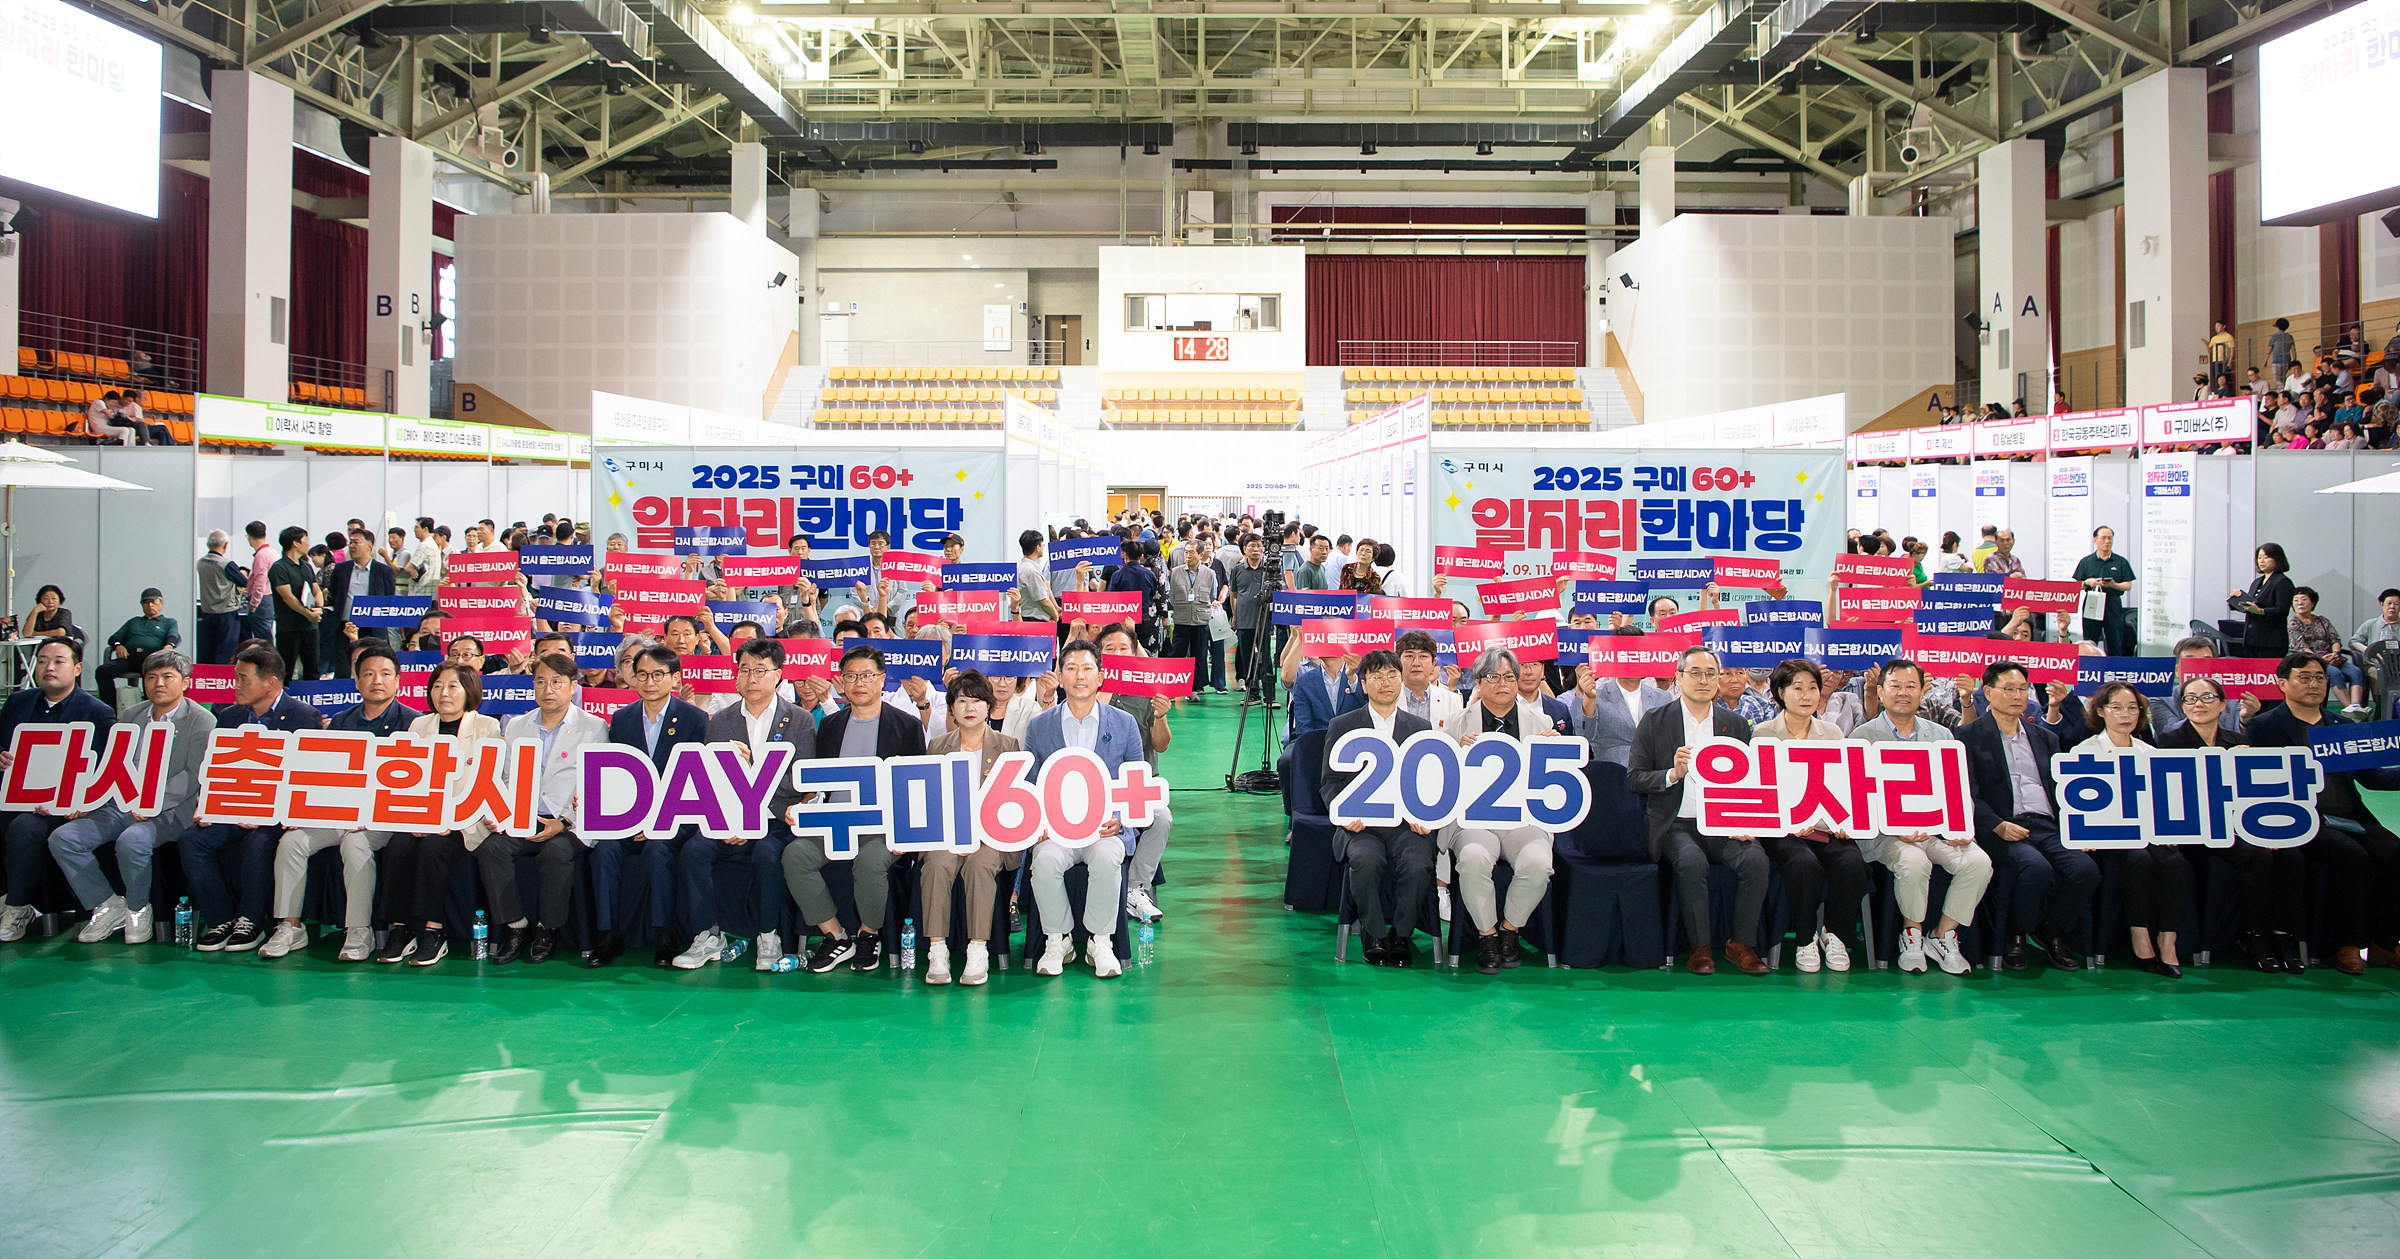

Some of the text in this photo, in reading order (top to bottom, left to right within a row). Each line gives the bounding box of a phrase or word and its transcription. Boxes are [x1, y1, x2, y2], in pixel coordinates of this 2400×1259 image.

[2323, 27, 2355, 51] 2025
[376, 295, 392, 317] B
[411, 293, 420, 315] B
[1993, 291, 2002, 314] A
[2021, 294, 2039, 317] A
[1176, 337, 1228, 360] 14 28
[462, 392, 477, 412] B
[1927, 393, 1943, 412] A
[275, 417, 299, 433] 이력서
[301, 420, 316, 435] 사진
[318, 422, 332, 436] 촬영
[2174, 416, 2228, 435] 구미버스(주)
[2000, 432, 2026, 446] 강남병원
[2061, 423, 2131, 442] 한국공동주택관리(주)
[625, 460, 664, 472] 구미시
[1463, 462, 1504, 473] 구미시
[692, 464, 914, 490] 2025 구미 60+
[1533, 465, 1756, 492] 2025 구미 60+
[675, 536, 745, 546] 다시 출근합시DAY
[521, 555, 592, 565] 다시 출근합시DAY
[1050, 546, 1119, 561] 다시 출근합시DAY
[449, 561, 517, 573] 다시 출근합시DAY
[606, 563, 625, 572] 다시
[625, 564, 679, 575] 출근합시DAY
[881, 561, 896, 571] 다시
[1436, 557, 1503, 570] 다시 출근합시DAY
[1512, 564, 1532, 576] 09.
[1553, 562, 1568, 572] 다시
[1568, 562, 1616, 575] 출근합시DAY
[725, 567, 742, 577] 다시
[743, 565, 798, 577] 출근합시DAY
[801, 567, 870, 579] 다시 출근합시DAY
[1637, 569, 1655, 579] 다시
[1656, 569, 1713, 579] 출근합시DAY
[1725, 567, 1777, 579] 출근합시DAY
[1836, 563, 1911, 578] 다시 출근합시DAY
[943, 573, 1015, 584] 다시 출근합시DAY
[538, 597, 553, 608] 다시
[617, 590, 704, 604] 다시 출근합시DAY
[1481, 588, 1556, 605] 다시 출근합시DAY
[1577, 592, 1597, 602] 다시
[1598, 592, 1647, 604] 출근합시DAY
[2004, 589, 2079, 603] 다시 출근합시DAY
[439, 598, 518, 609] 다시 출근합시DAY
[918, 602, 997, 614] 다시 출근합시DAY
[1063, 602, 1140, 613] 다시 출근합시DAY
[1274, 603, 1354, 616] 다시 출근합시DAY
[1841, 599, 1920, 610] 다시 출근합시DAY
[351, 606, 429, 617] 다시 출근합시DAY
[1372, 609, 1451, 620] 다시 출근합시DAY
[1748, 611, 1822, 624] 다시 출근합시DAY
[714, 612, 774, 625] 출근합시DAY
[1917, 620, 1992, 633] 다시 출근합시DAY
[1304, 633, 1392, 645] 다시 출근합시DAY
[1458, 641, 1482, 653] 다시
[1483, 633, 1555, 652] 출근합시DAY
[1557, 642, 1577, 653] 다시
[1704, 641, 1803, 654] 다시 출근합시DAY
[1804, 643, 1899, 656] 다시 출근합시DAY
[883, 653, 940, 666] 근합시DAY
[953, 649, 1050, 663] 다시 출근합시DAY
[1591, 651, 1614, 663] 다시
[1917, 650, 1984, 664] 출근합시DAY
[682, 668, 701, 680] 다시
[1120, 669, 1192, 685] 출근합시DAY
[2077, 669, 2173, 684] 다시 출근합시DAY
[312, 692, 362, 706] 출근합시D
[482, 689, 503, 700] 다시
[584, 702, 605, 714] 다시
[2313, 736, 2400, 758] 다시 출근합시
[4, 729, 166, 809] 다시
[204, 731, 537, 830] 출근합시
[583, 750, 788, 832] DAY
[1336, 739, 2315, 842] 2025 일자리 한마당
